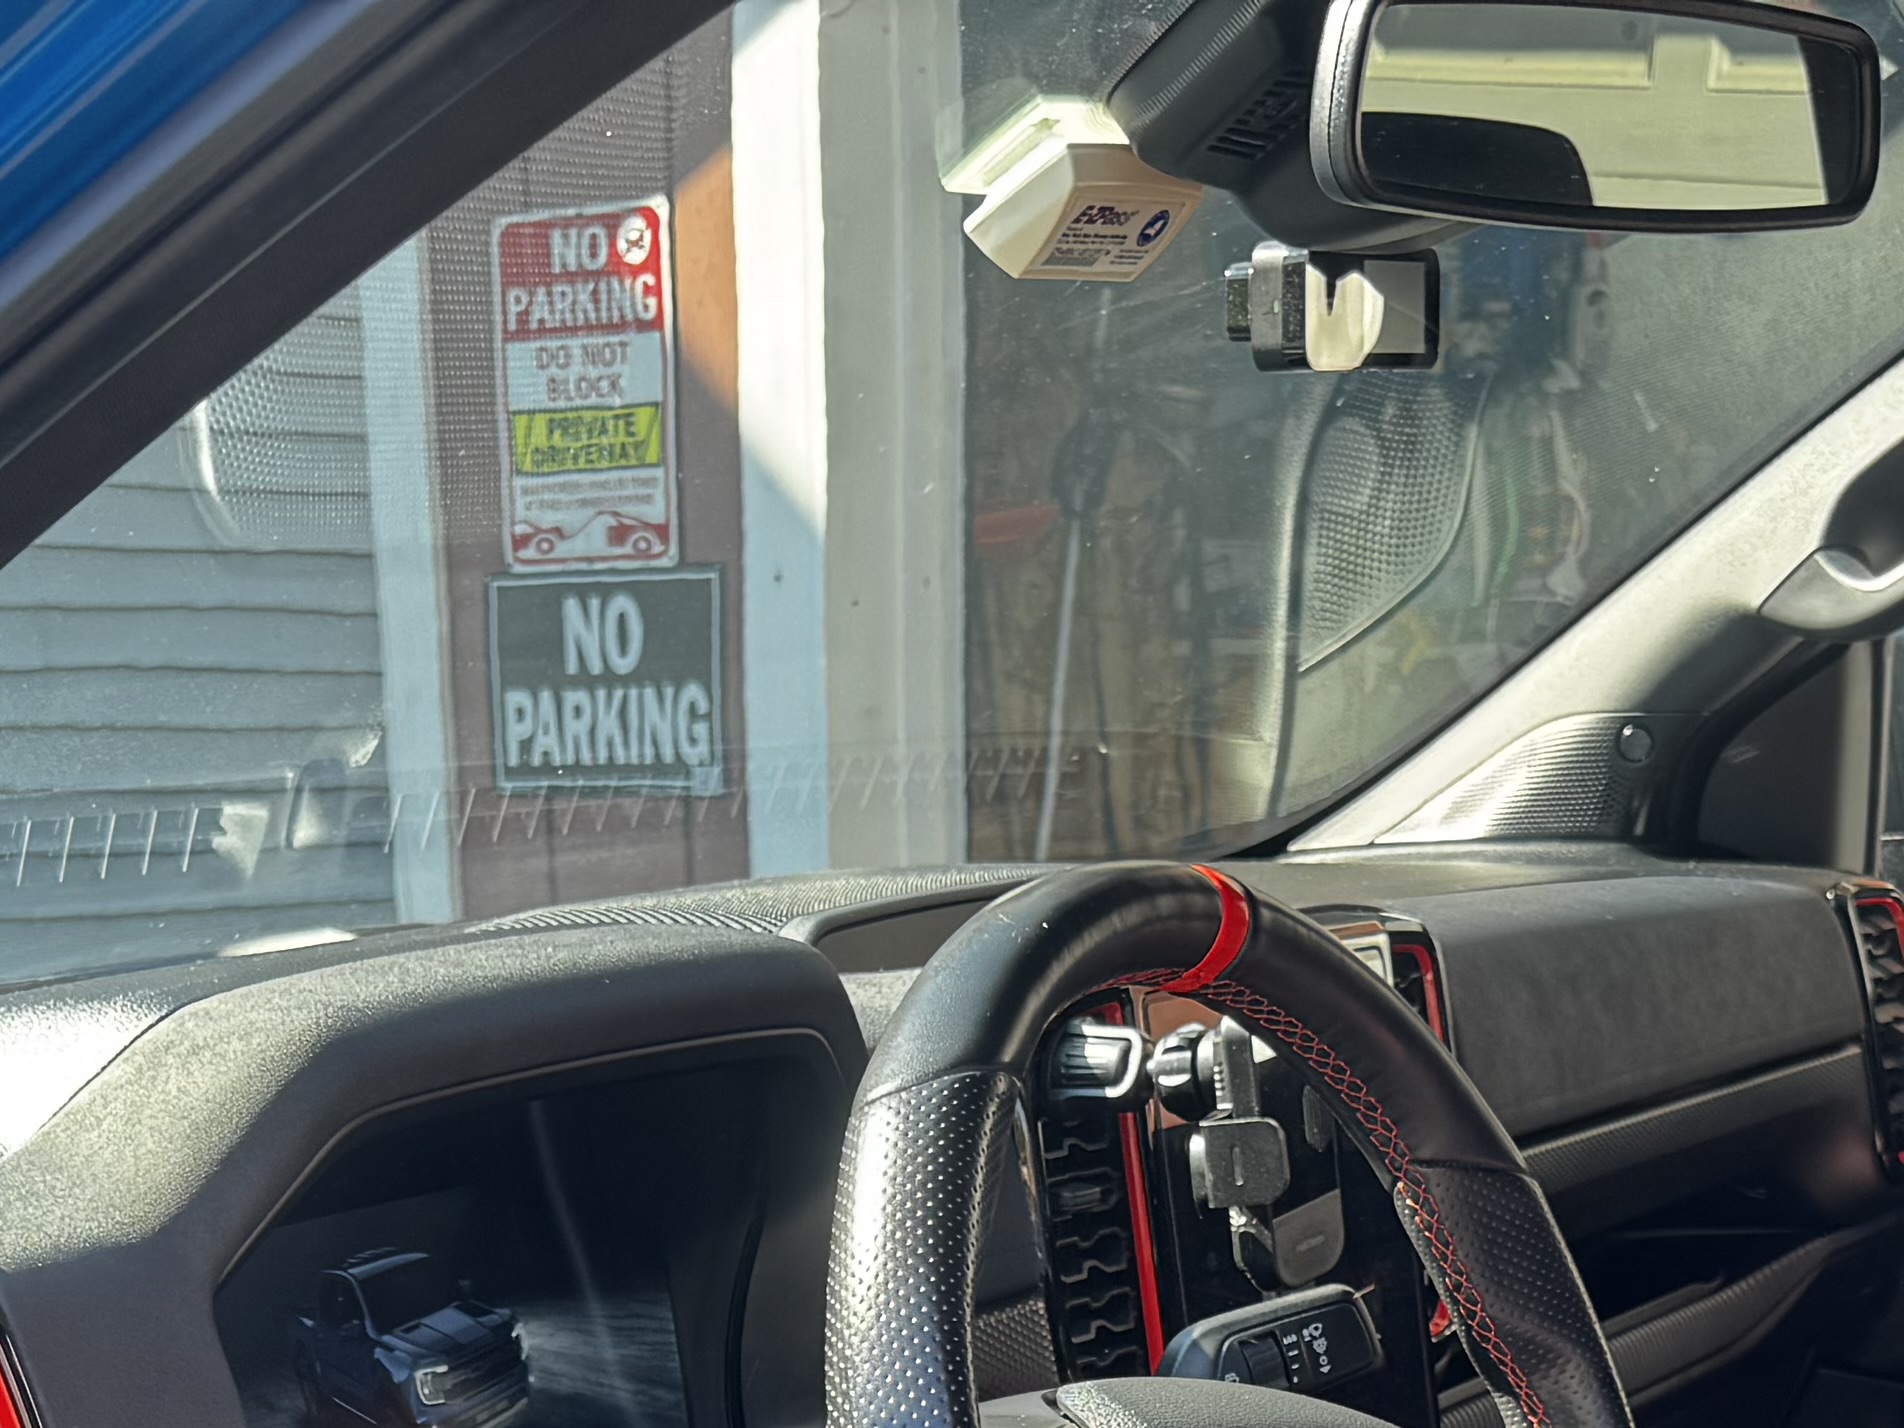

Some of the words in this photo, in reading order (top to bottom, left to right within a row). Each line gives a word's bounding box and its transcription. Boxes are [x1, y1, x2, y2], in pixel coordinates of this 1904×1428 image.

[550, 224, 609, 275] NO
[505, 272, 659, 332] PARKING
[535, 344, 572, 371] DO
[580, 340, 630, 368] NOT
[547, 372, 626, 402] BLOCK
[547, 411, 637, 445] PRIVATE
[561, 591, 645, 676] NO
[503, 679, 713, 768] PARKING
